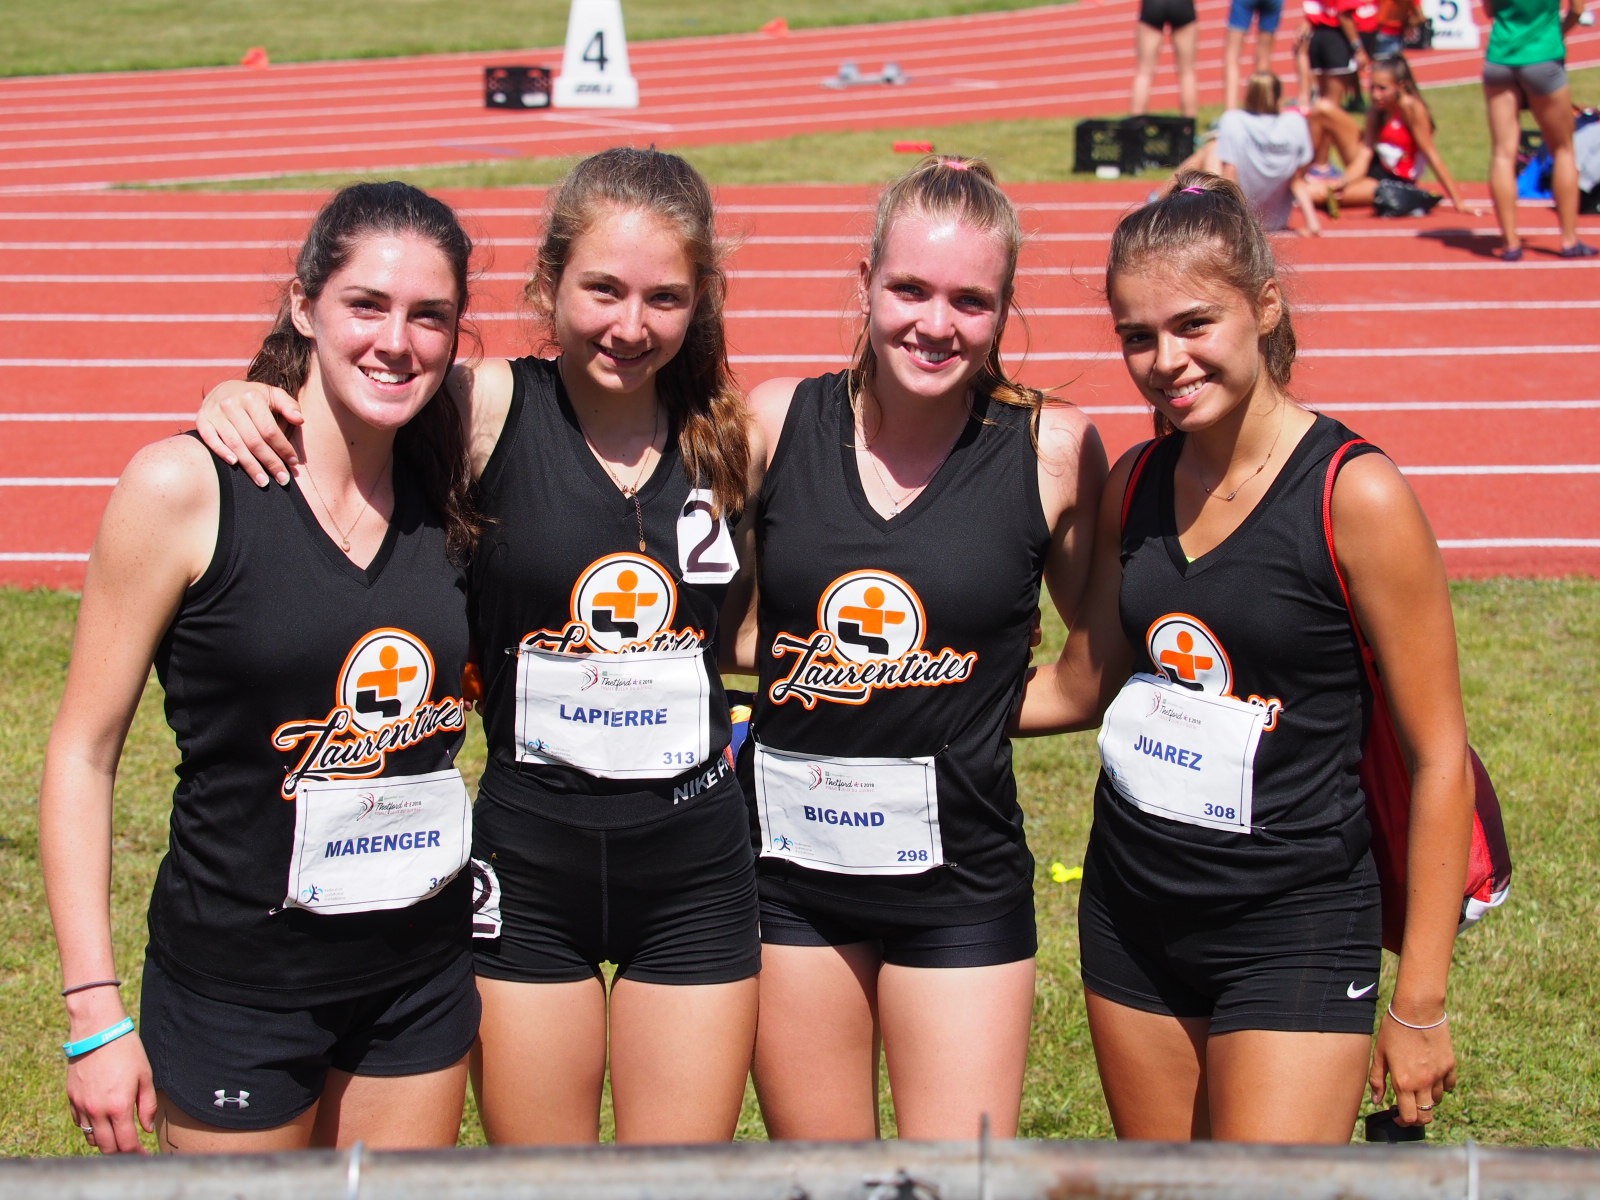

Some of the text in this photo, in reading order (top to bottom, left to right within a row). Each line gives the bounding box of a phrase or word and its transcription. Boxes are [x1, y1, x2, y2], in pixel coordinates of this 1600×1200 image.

[1439, 0, 1459, 22] 5
[582, 30, 608, 71] 4
[683, 500, 733, 573] 2
[769, 630, 978, 710] Laurentides
[601, 677, 632, 691] Thetford
[559, 703, 668, 727] LAPIERRE
[271, 697, 466, 800] Laurentides
[663, 751, 695, 765] 313
[1134, 734, 1203, 771] JUAREZ
[673, 766, 719, 806] NIKE
[825, 777, 854, 791] Thetford
[803, 805, 885, 827] BIGAND
[1203, 803, 1236, 820] 308
[324, 830, 441, 858] MARENGER
[896, 850, 928, 862] 298
